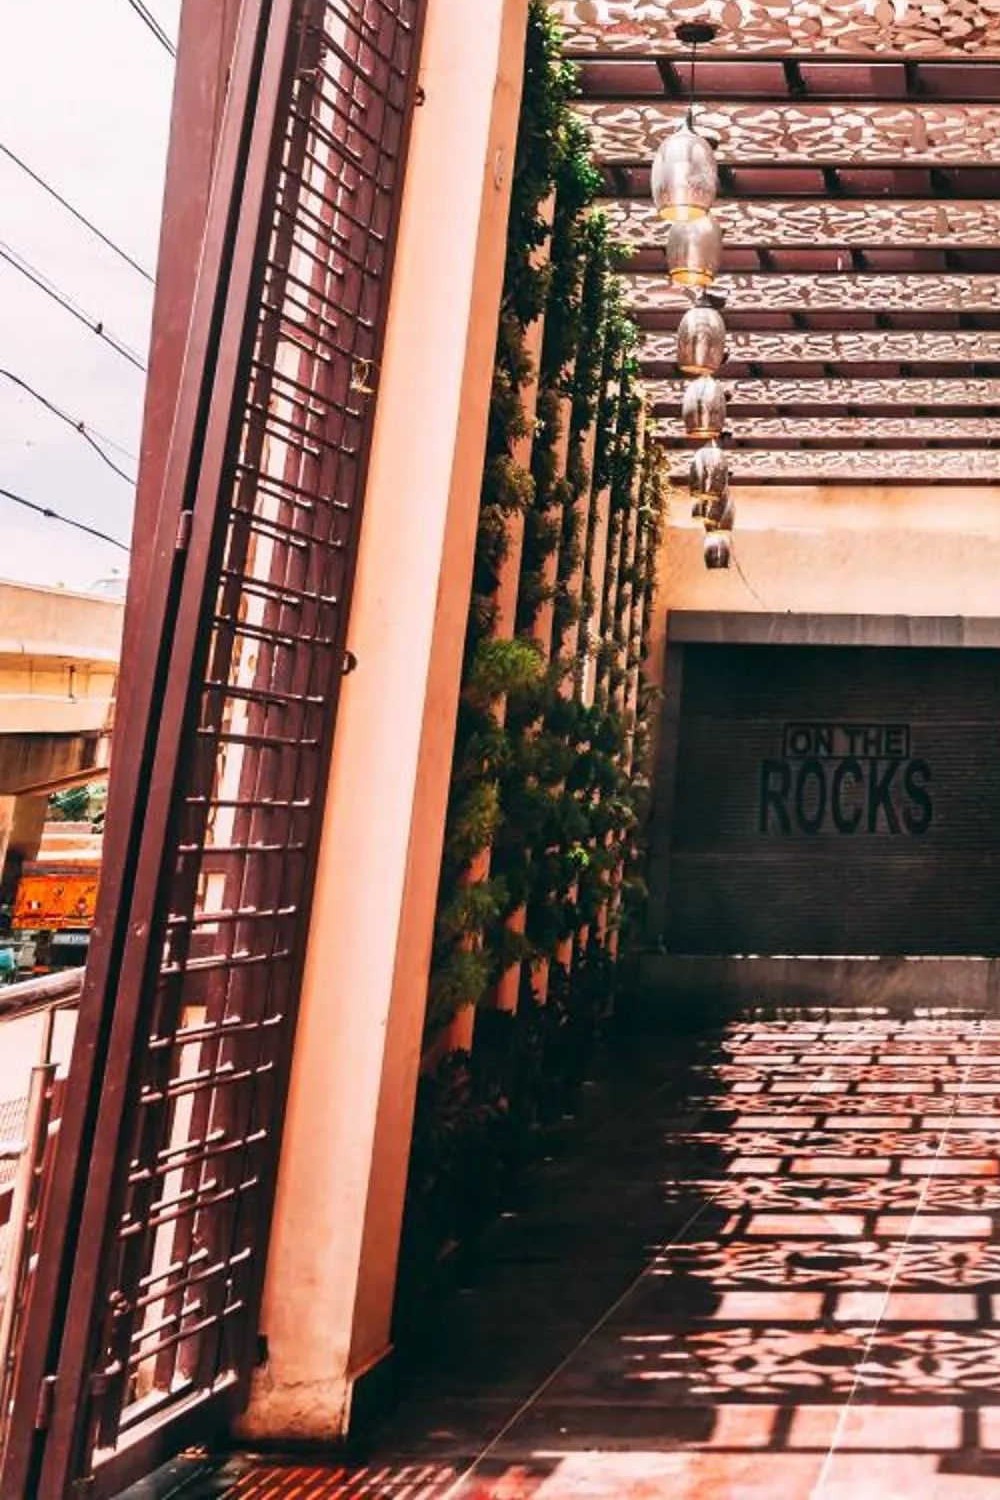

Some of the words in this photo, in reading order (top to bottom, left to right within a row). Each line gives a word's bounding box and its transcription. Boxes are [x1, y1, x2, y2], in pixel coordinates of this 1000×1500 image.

[788, 729, 835, 755] ON
[843, 728, 905, 755] THE
[758, 758, 935, 836] ROCKS
